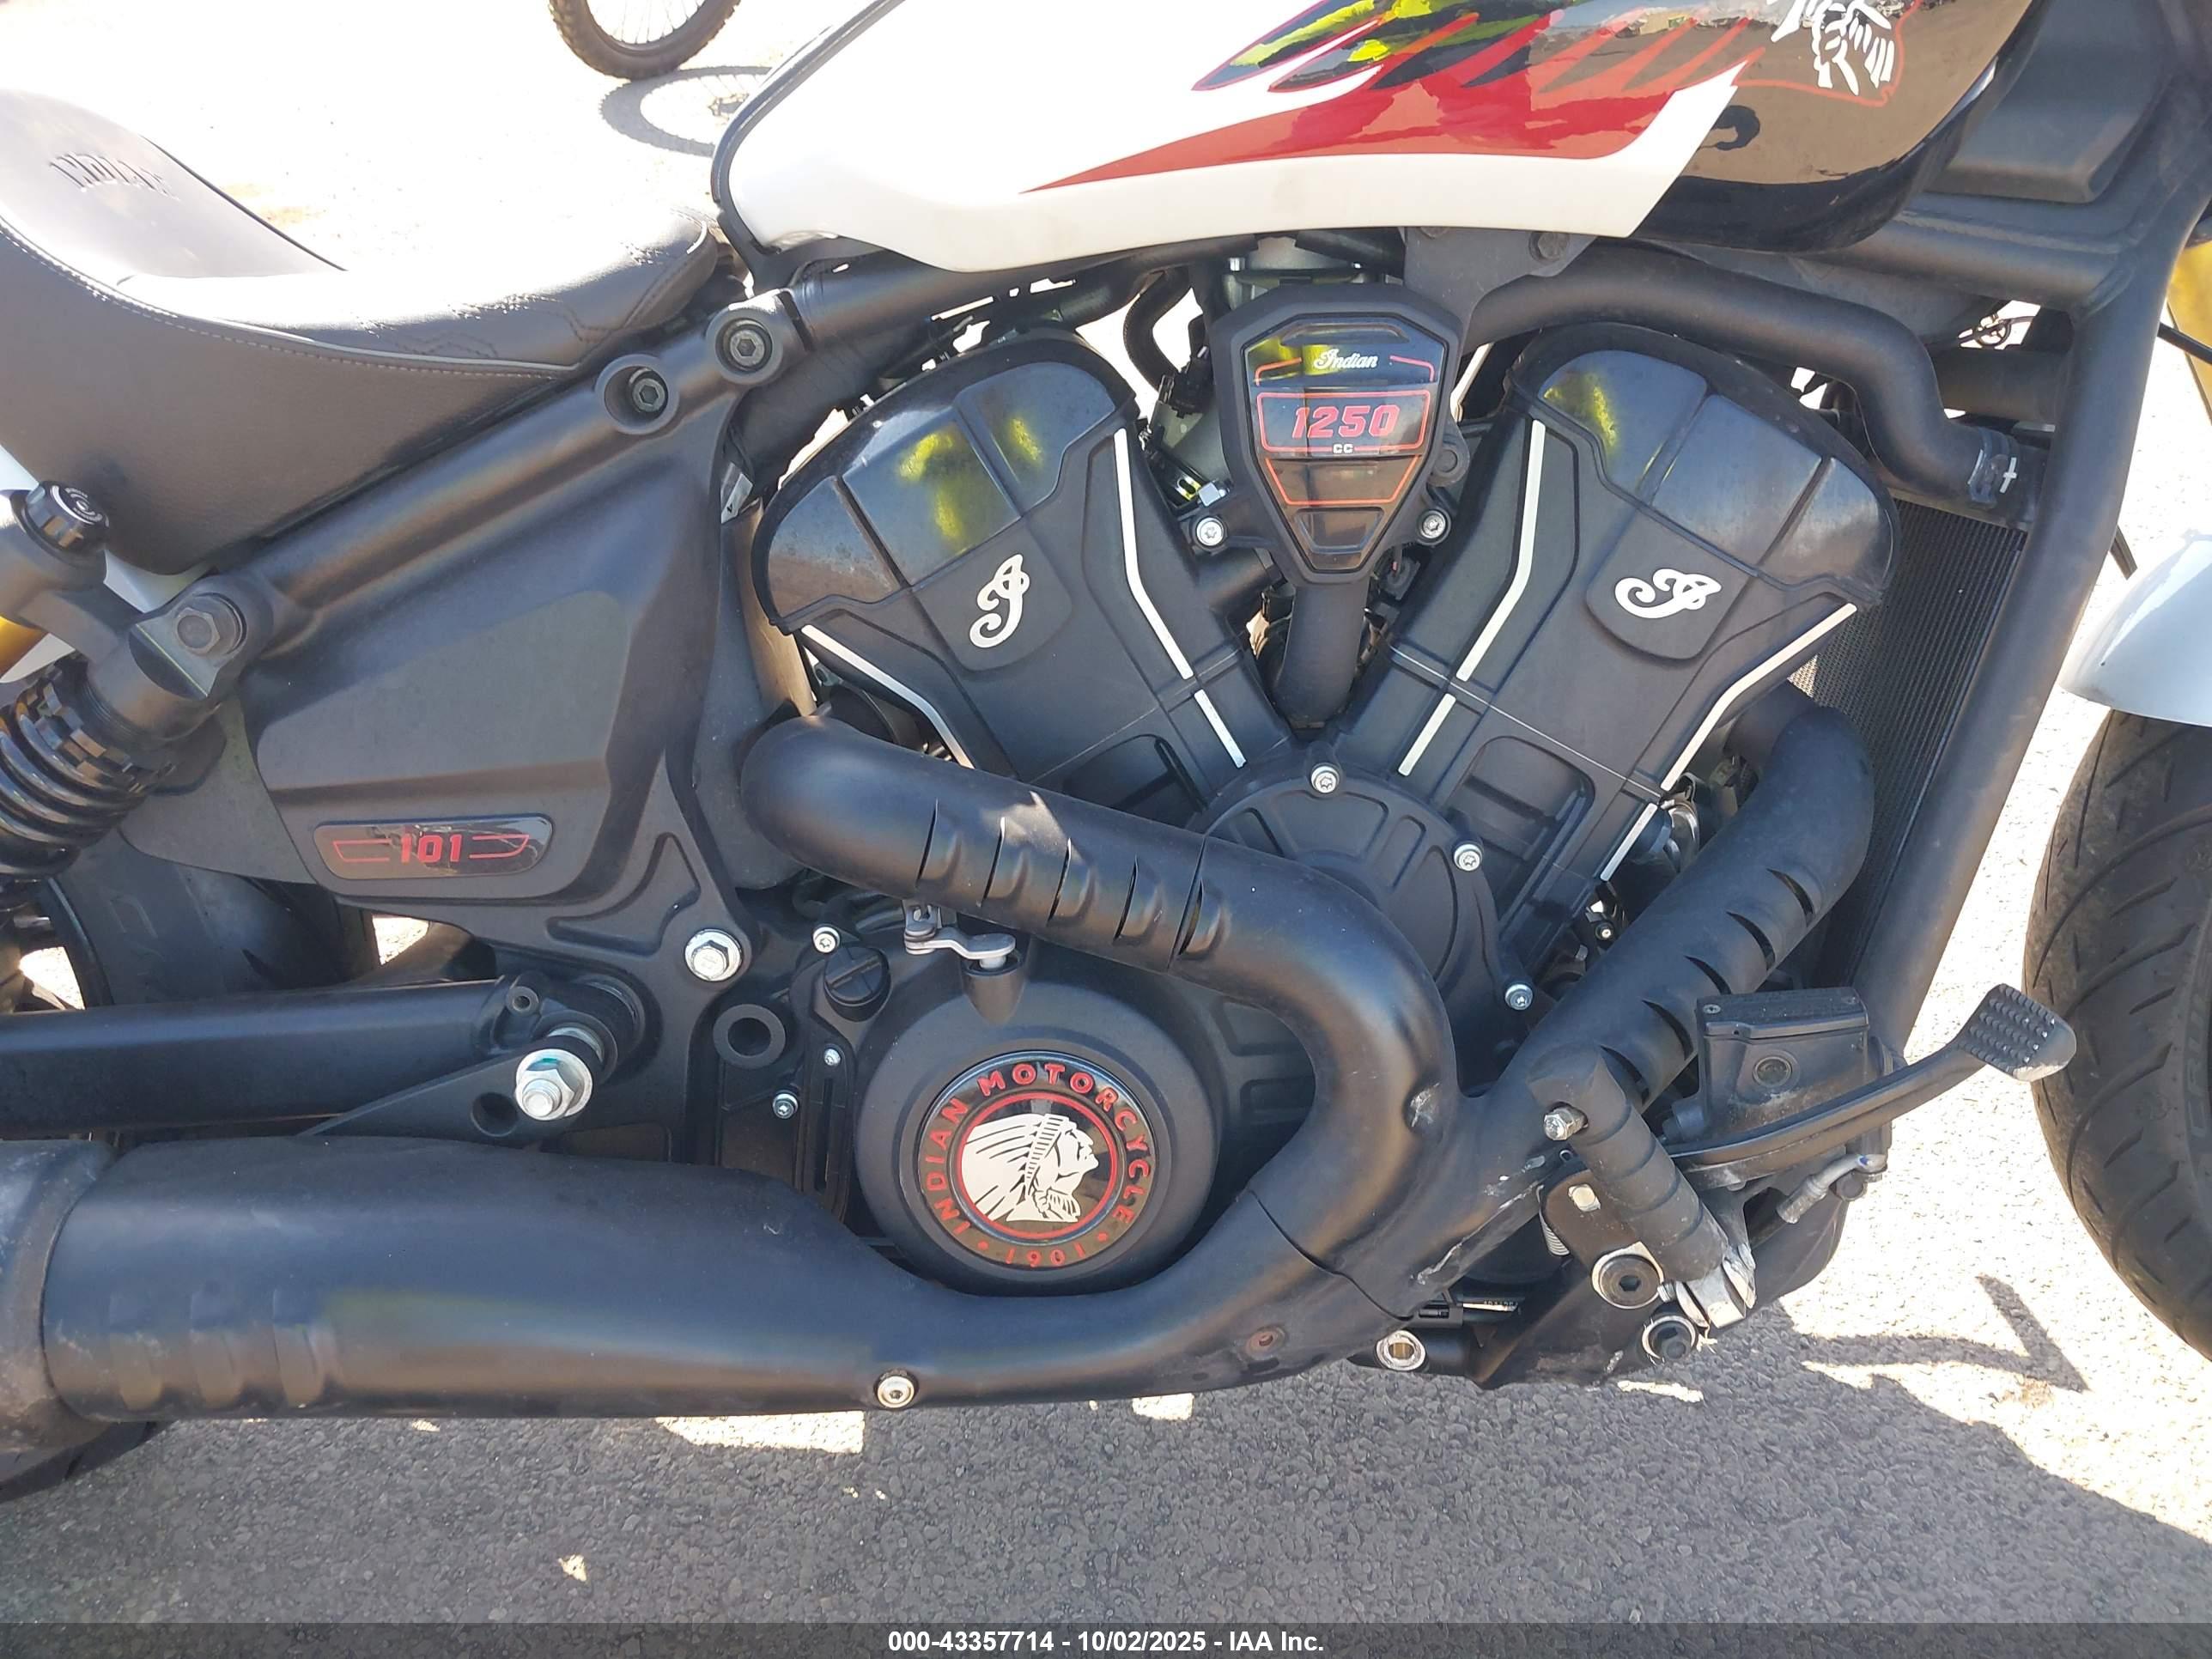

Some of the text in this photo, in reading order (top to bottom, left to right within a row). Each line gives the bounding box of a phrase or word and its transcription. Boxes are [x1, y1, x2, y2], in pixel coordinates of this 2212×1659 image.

[1313, 348, 1379, 370] Indian
[1291, 404, 1401, 439] 1250
[399, 832, 464, 865] 101
[924, 1061, 1152, 1236] INDIAN MOTORCYCLE
[1003, 1241, 1087, 1269] 1901
